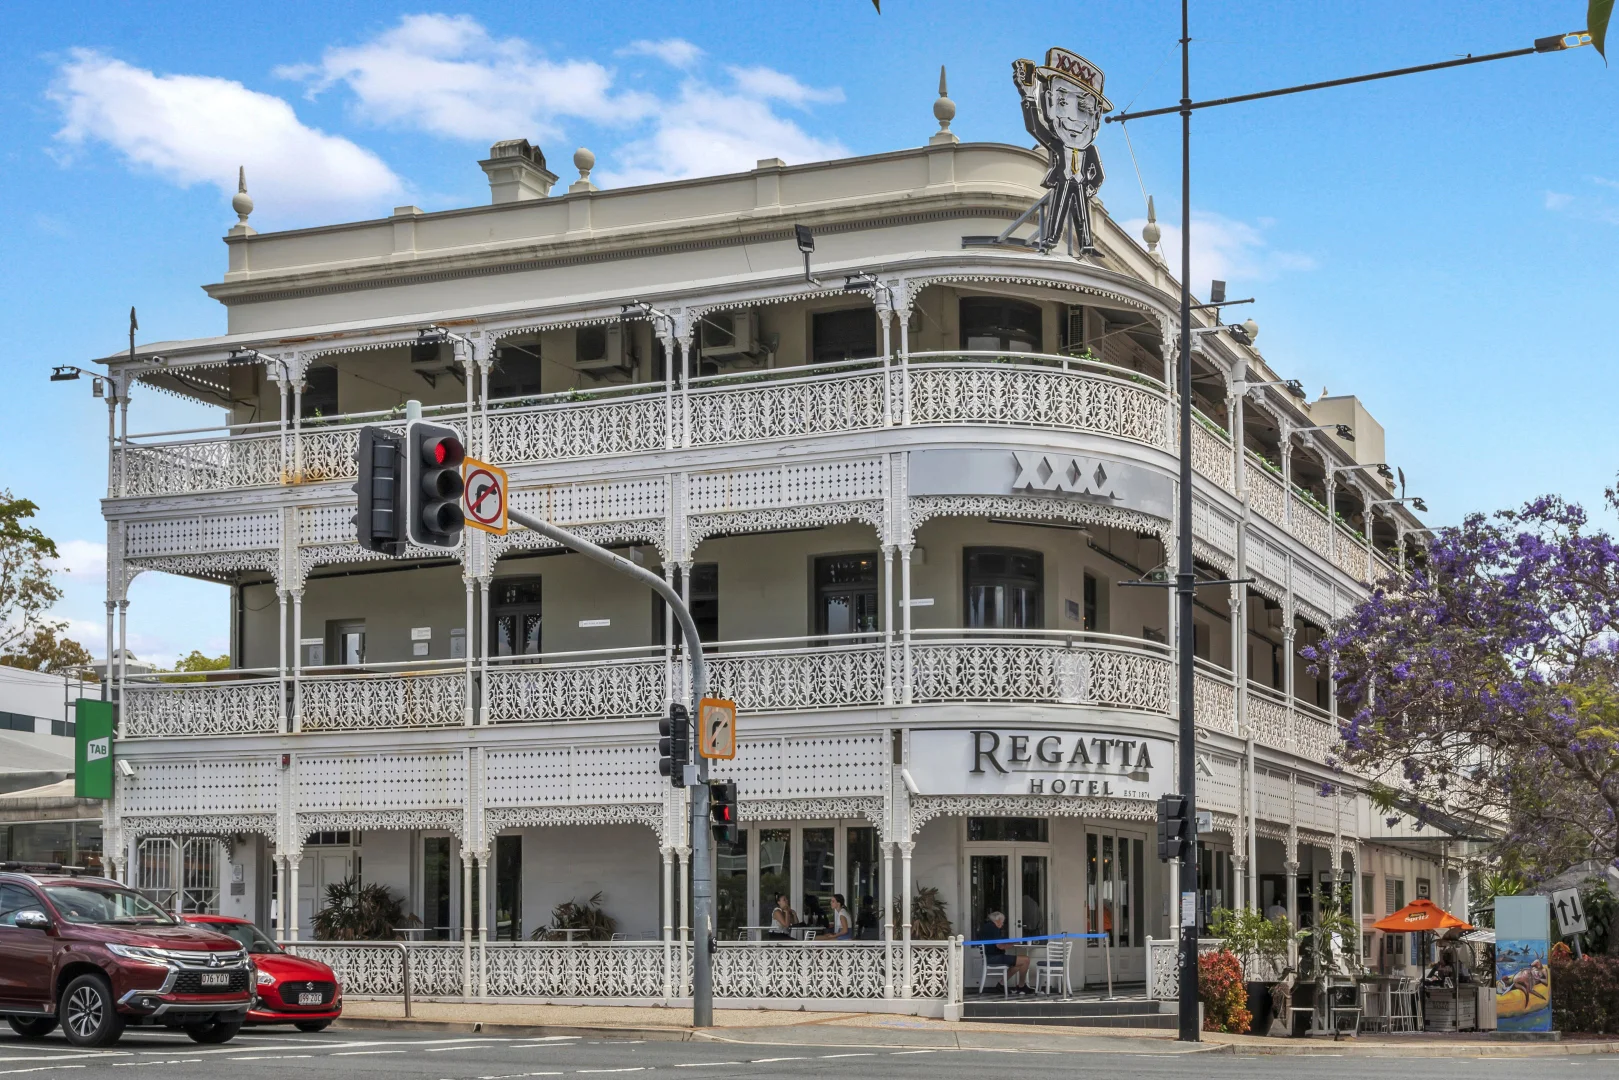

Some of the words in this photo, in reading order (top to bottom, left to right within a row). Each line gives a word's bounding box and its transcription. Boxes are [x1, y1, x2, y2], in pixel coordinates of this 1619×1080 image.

[1056, 53, 1096, 87] XXXX
[90, 743, 107, 755] TAB
[969, 730, 1154, 774] REGATTA
[1029, 778, 1114, 795] HOTEL
[1123, 789, 1137, 798] EST
[1404, 914, 1430, 922] Spritz
